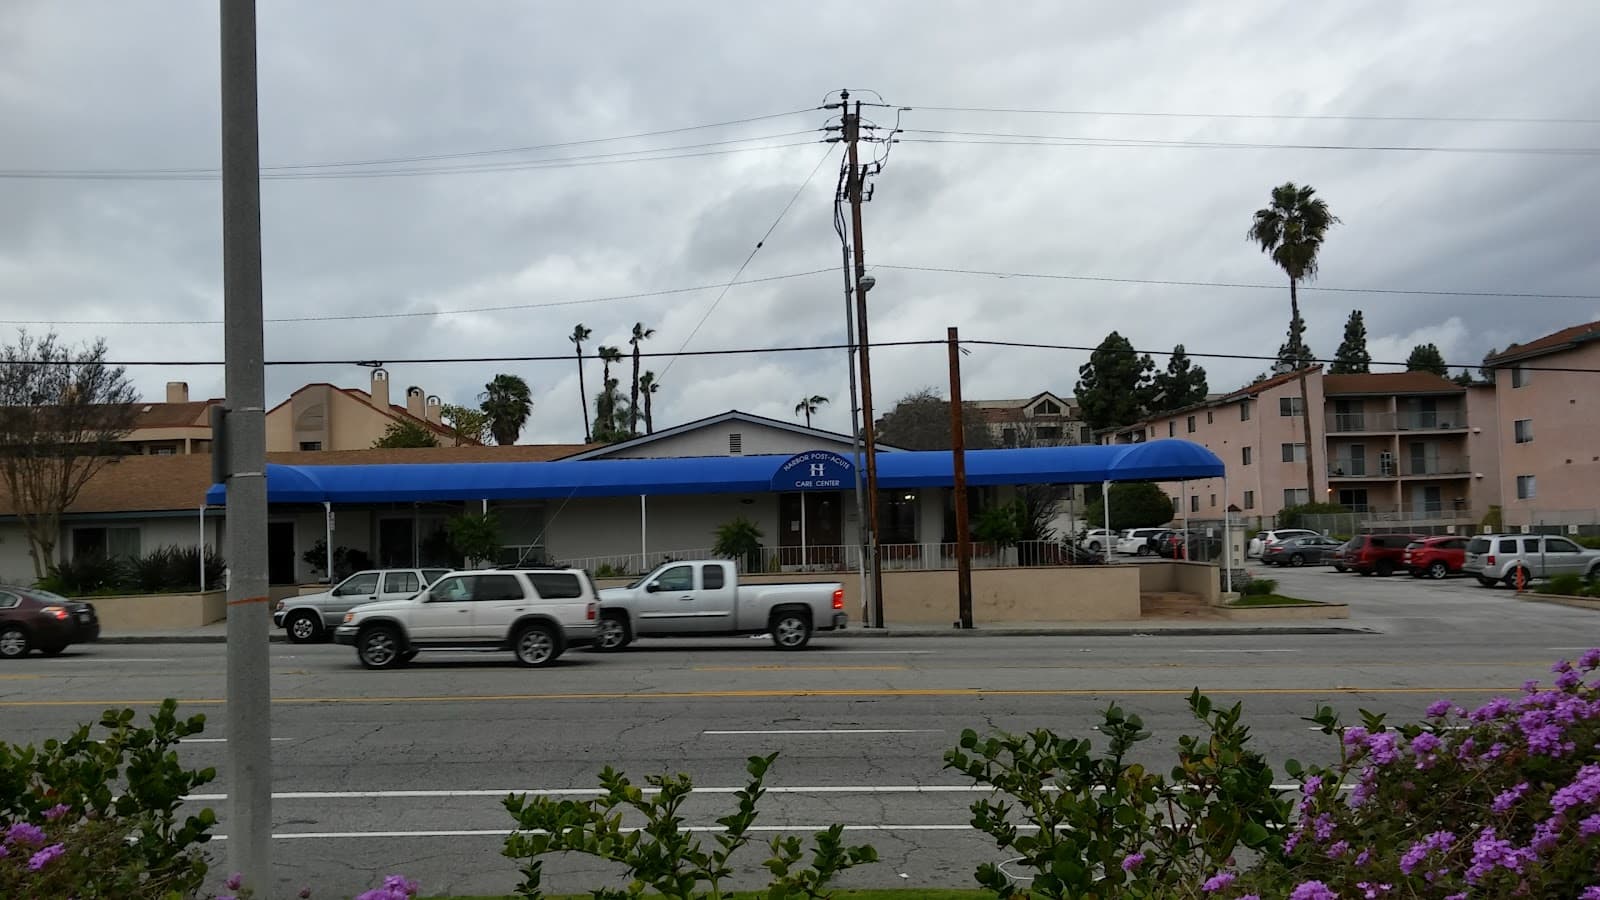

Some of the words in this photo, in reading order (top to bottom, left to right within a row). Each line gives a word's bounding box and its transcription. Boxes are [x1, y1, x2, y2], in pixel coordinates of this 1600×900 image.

[784, 454, 809, 471] HARBOR
[811, 453, 850, 469] POST-ACUTE
[810, 463, 824, 476] H
